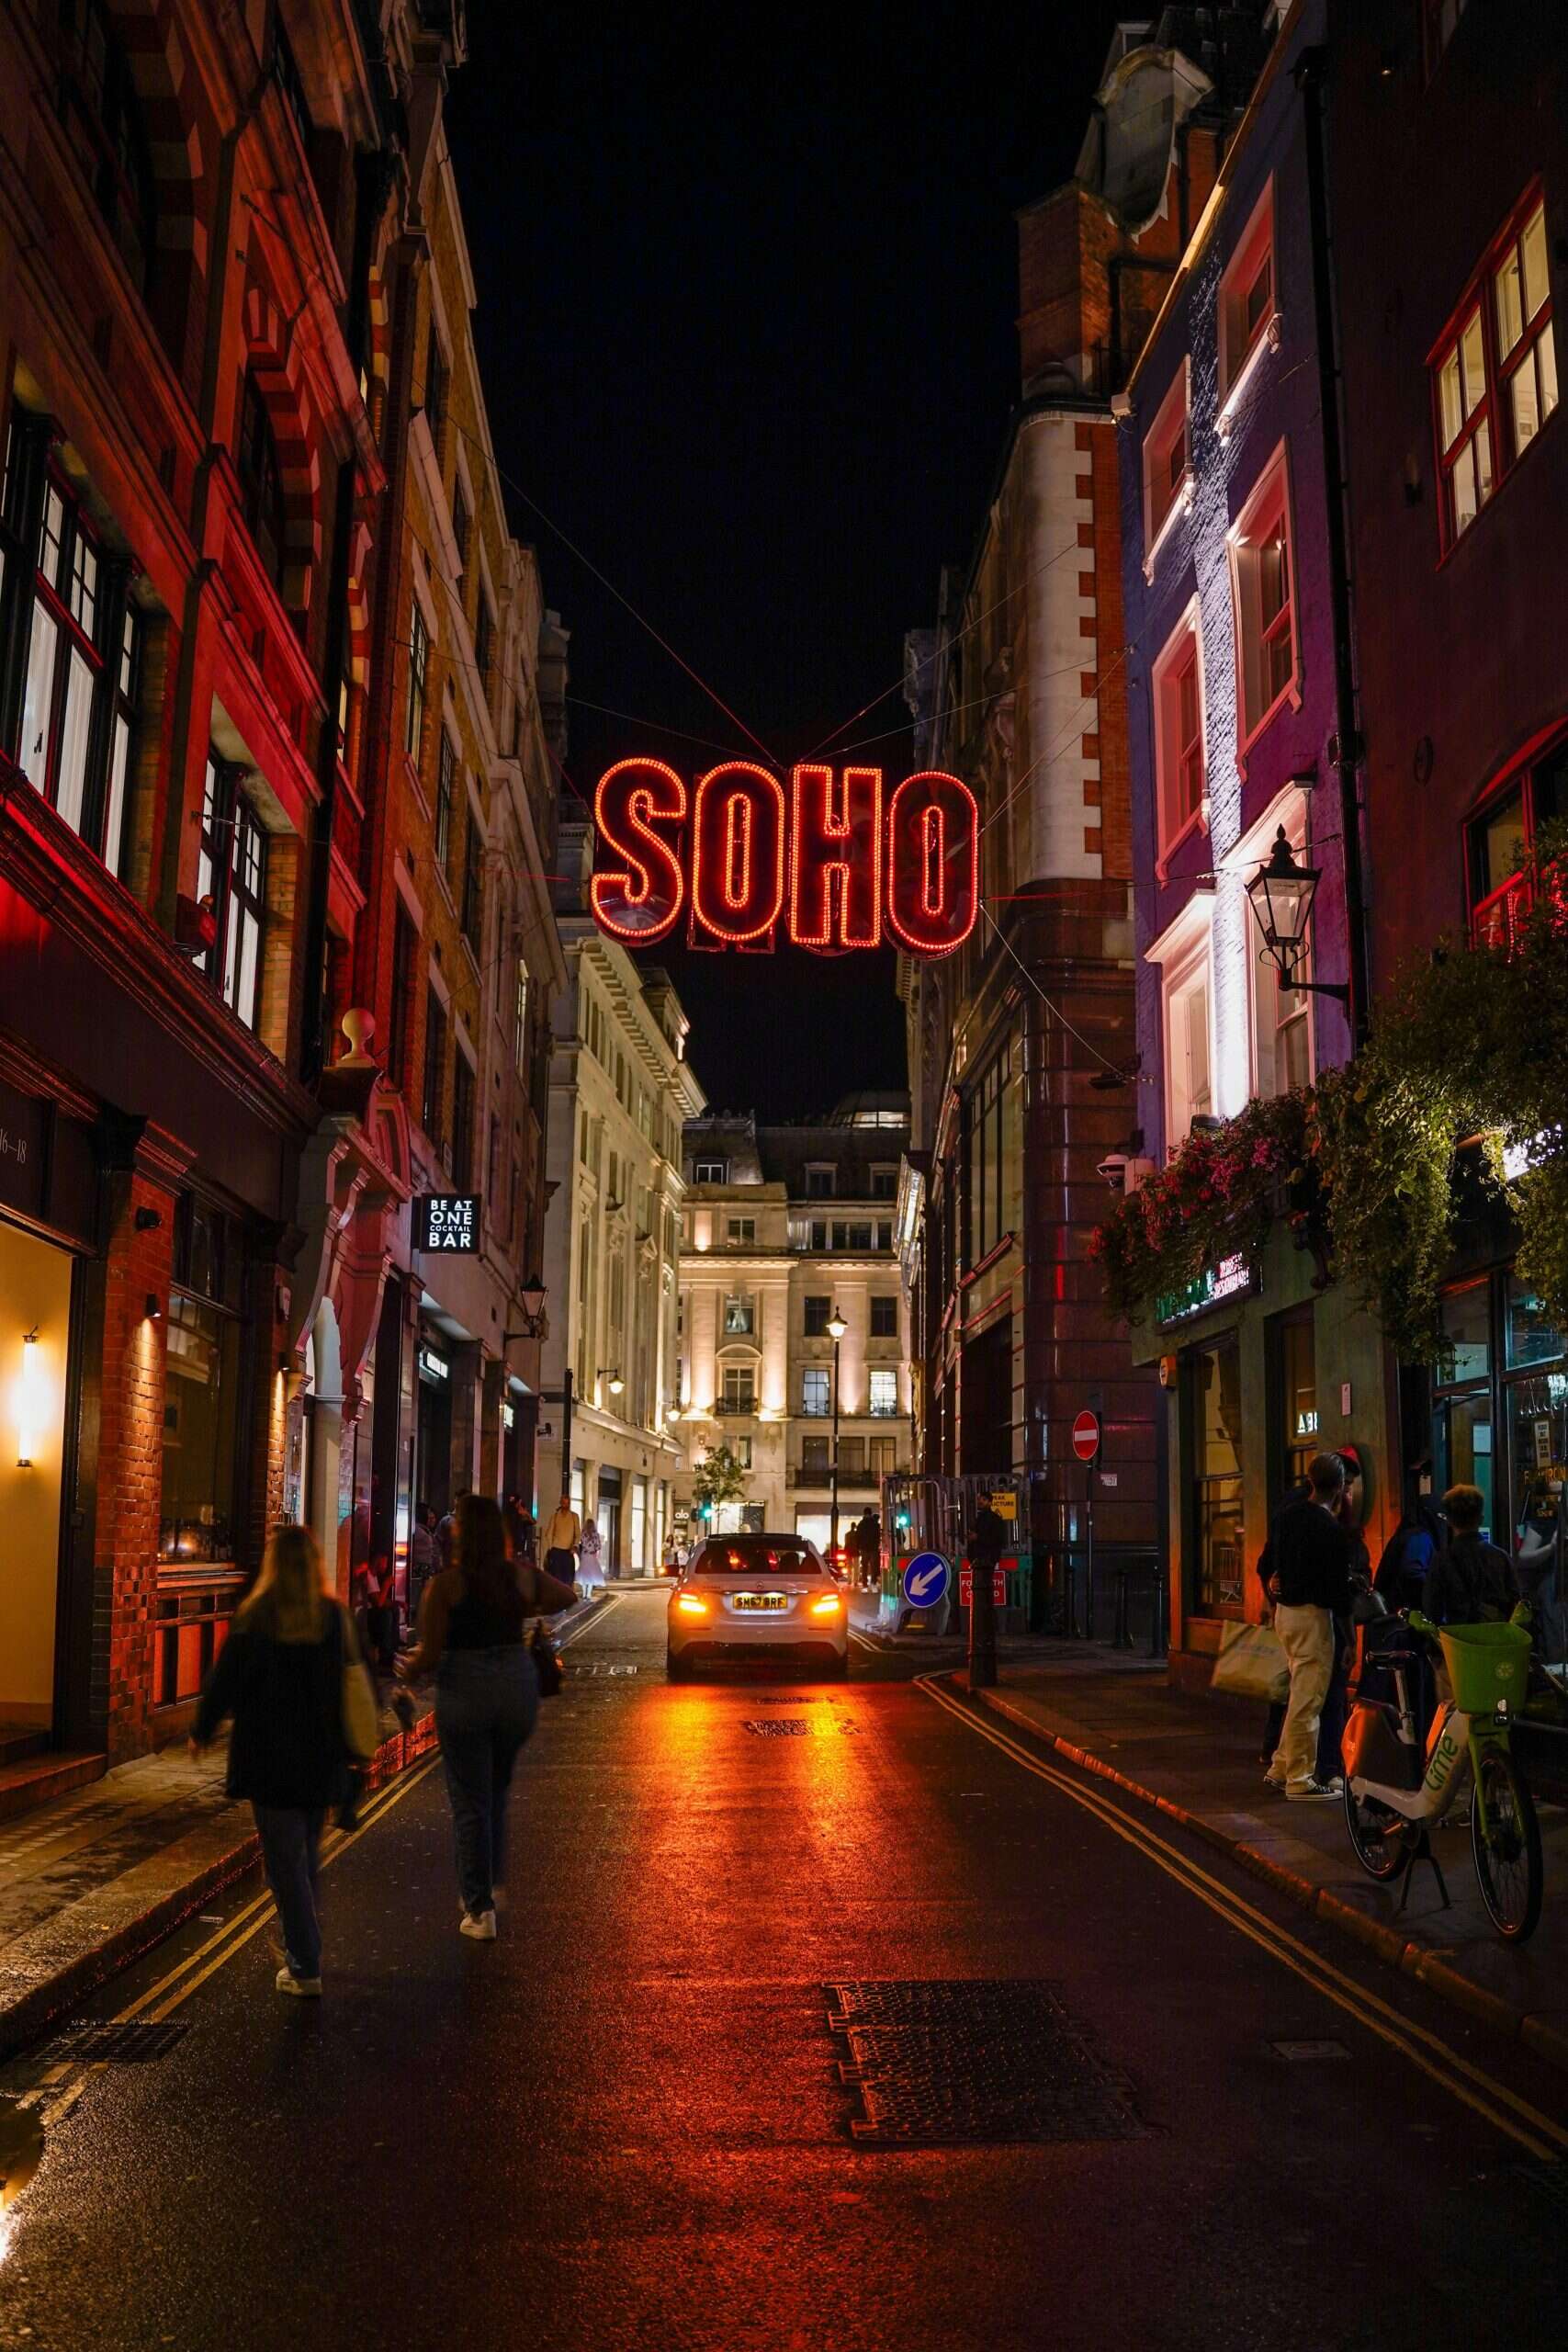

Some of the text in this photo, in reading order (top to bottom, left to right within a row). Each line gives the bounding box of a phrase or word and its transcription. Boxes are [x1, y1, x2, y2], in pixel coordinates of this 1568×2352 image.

[591, 757, 979, 951] SOHO
[430, 1199, 472, 1211] BE AT
[430, 1211, 472, 1226] ONE
[428, 1232, 471, 1248] BAR
[674, 1508, 690, 1520] alo
